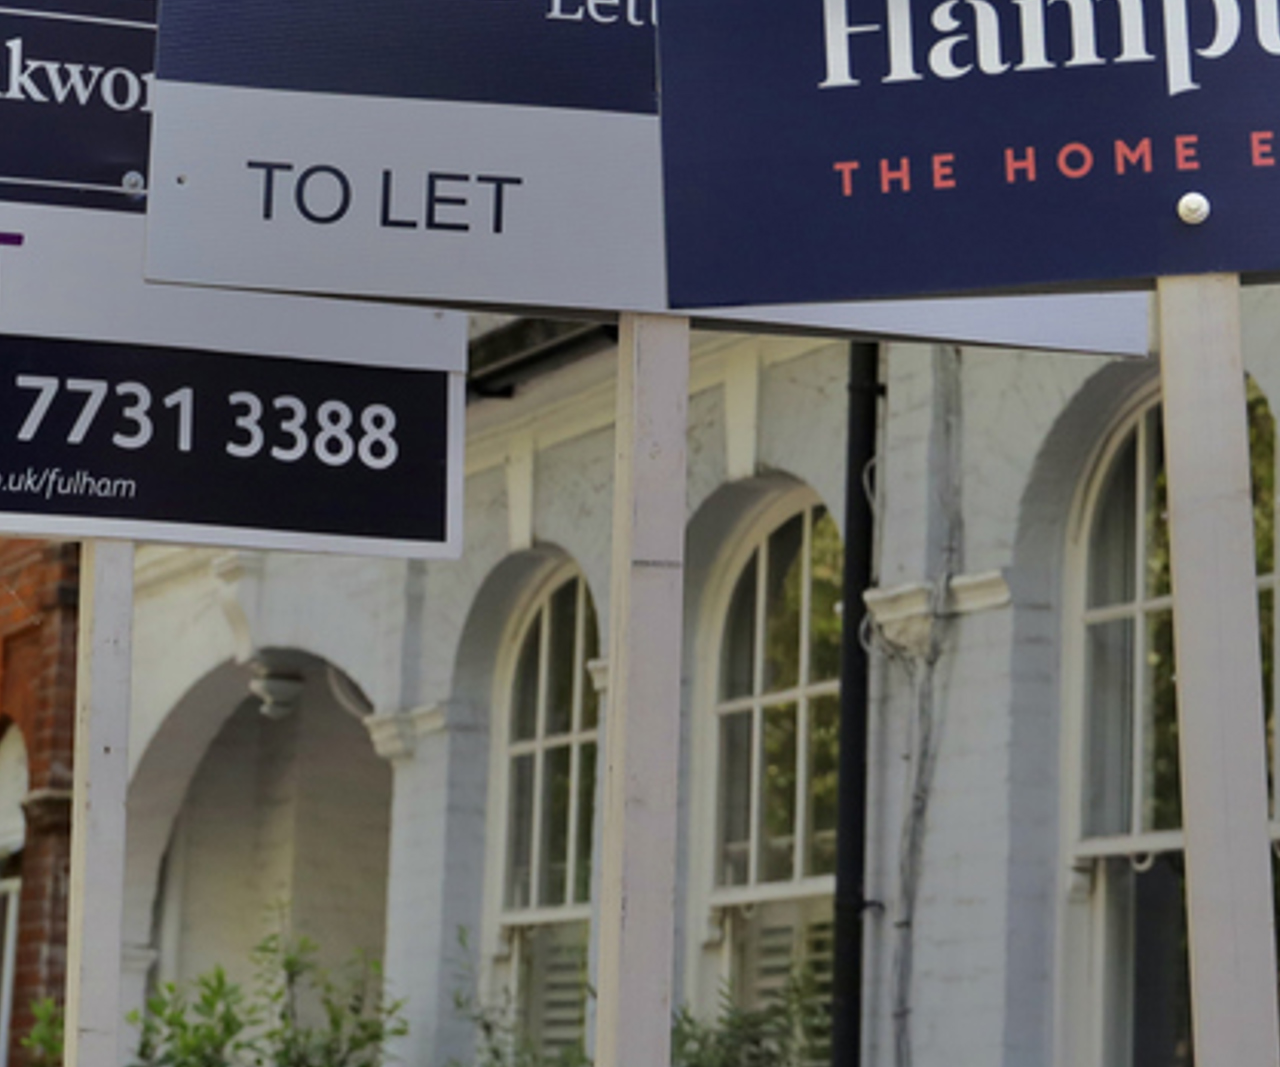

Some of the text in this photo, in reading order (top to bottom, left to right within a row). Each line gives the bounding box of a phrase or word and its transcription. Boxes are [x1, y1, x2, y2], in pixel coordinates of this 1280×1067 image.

[247, 160, 524, 235] TO LET
[834, 152, 956, 197] THE
[1004, 134, 1201, 184] HOME
[15, 374, 195, 452] 7731
[225, 391, 400, 470] 3388
